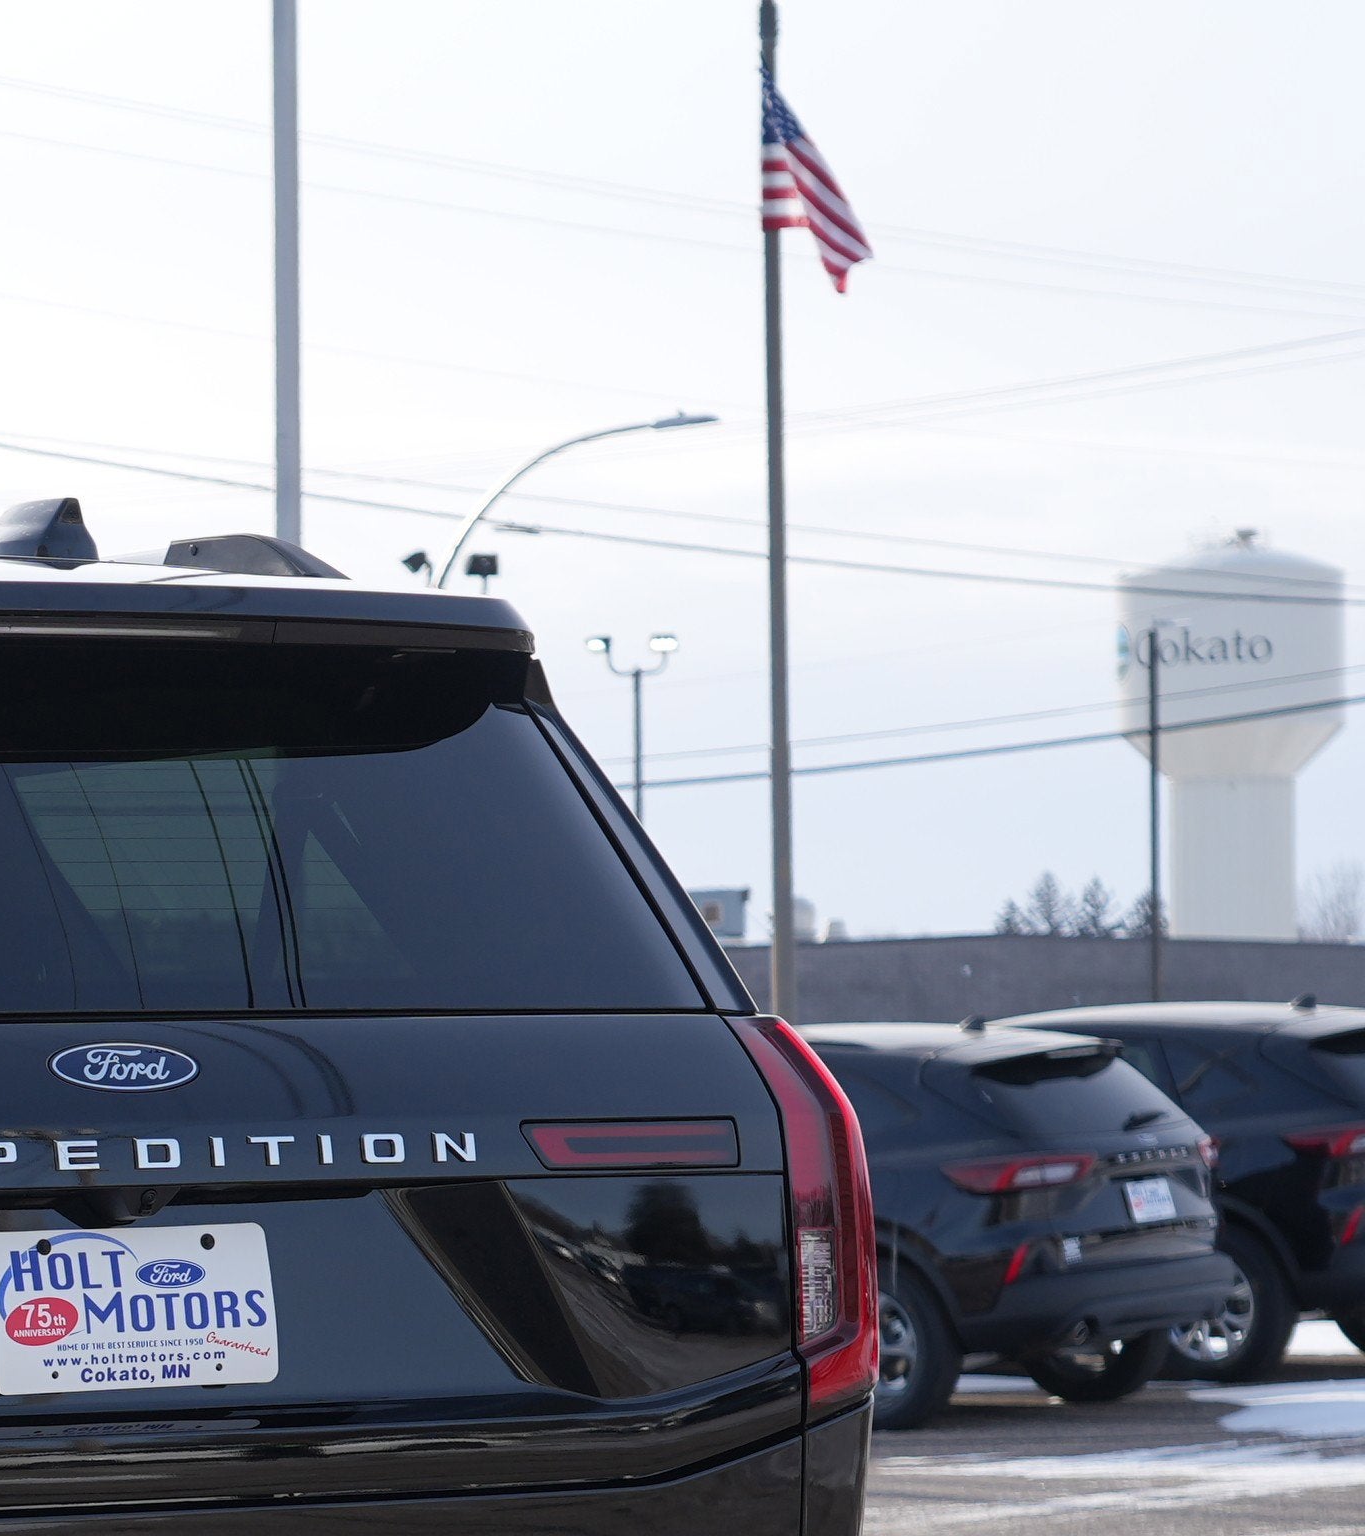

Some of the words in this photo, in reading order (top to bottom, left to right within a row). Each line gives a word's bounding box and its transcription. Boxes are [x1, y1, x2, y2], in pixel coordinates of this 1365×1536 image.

[84, 1049, 169, 1083] Ford
[10, 1250, 125, 1292] HOLT
[149, 1263, 192, 1285] Ford
[20, 1303, 67, 1330] 75th
[83, 1289, 267, 1334] MOTORS
[13, 1328, 67, 1338] ANNIVERSARY
[57, 1343, 79, 1352] HOME
[80, 1343, 90, 1351] OF
[91, 1342, 106, 1350] THE
[107, 1341, 125, 1350] BEST
[127, 1340, 158, 1349] SERVICE
[160, 1339, 182, 1348] SINCE
[185, 1338, 204, 1346] 1950
[206, 1332, 271, 1358] Guaranteed
[43, 1350, 226, 1368] www.holtmotors.com
[80, 1366, 155, 1383] Cokato,
[162, 1364, 191, 1379] MN
